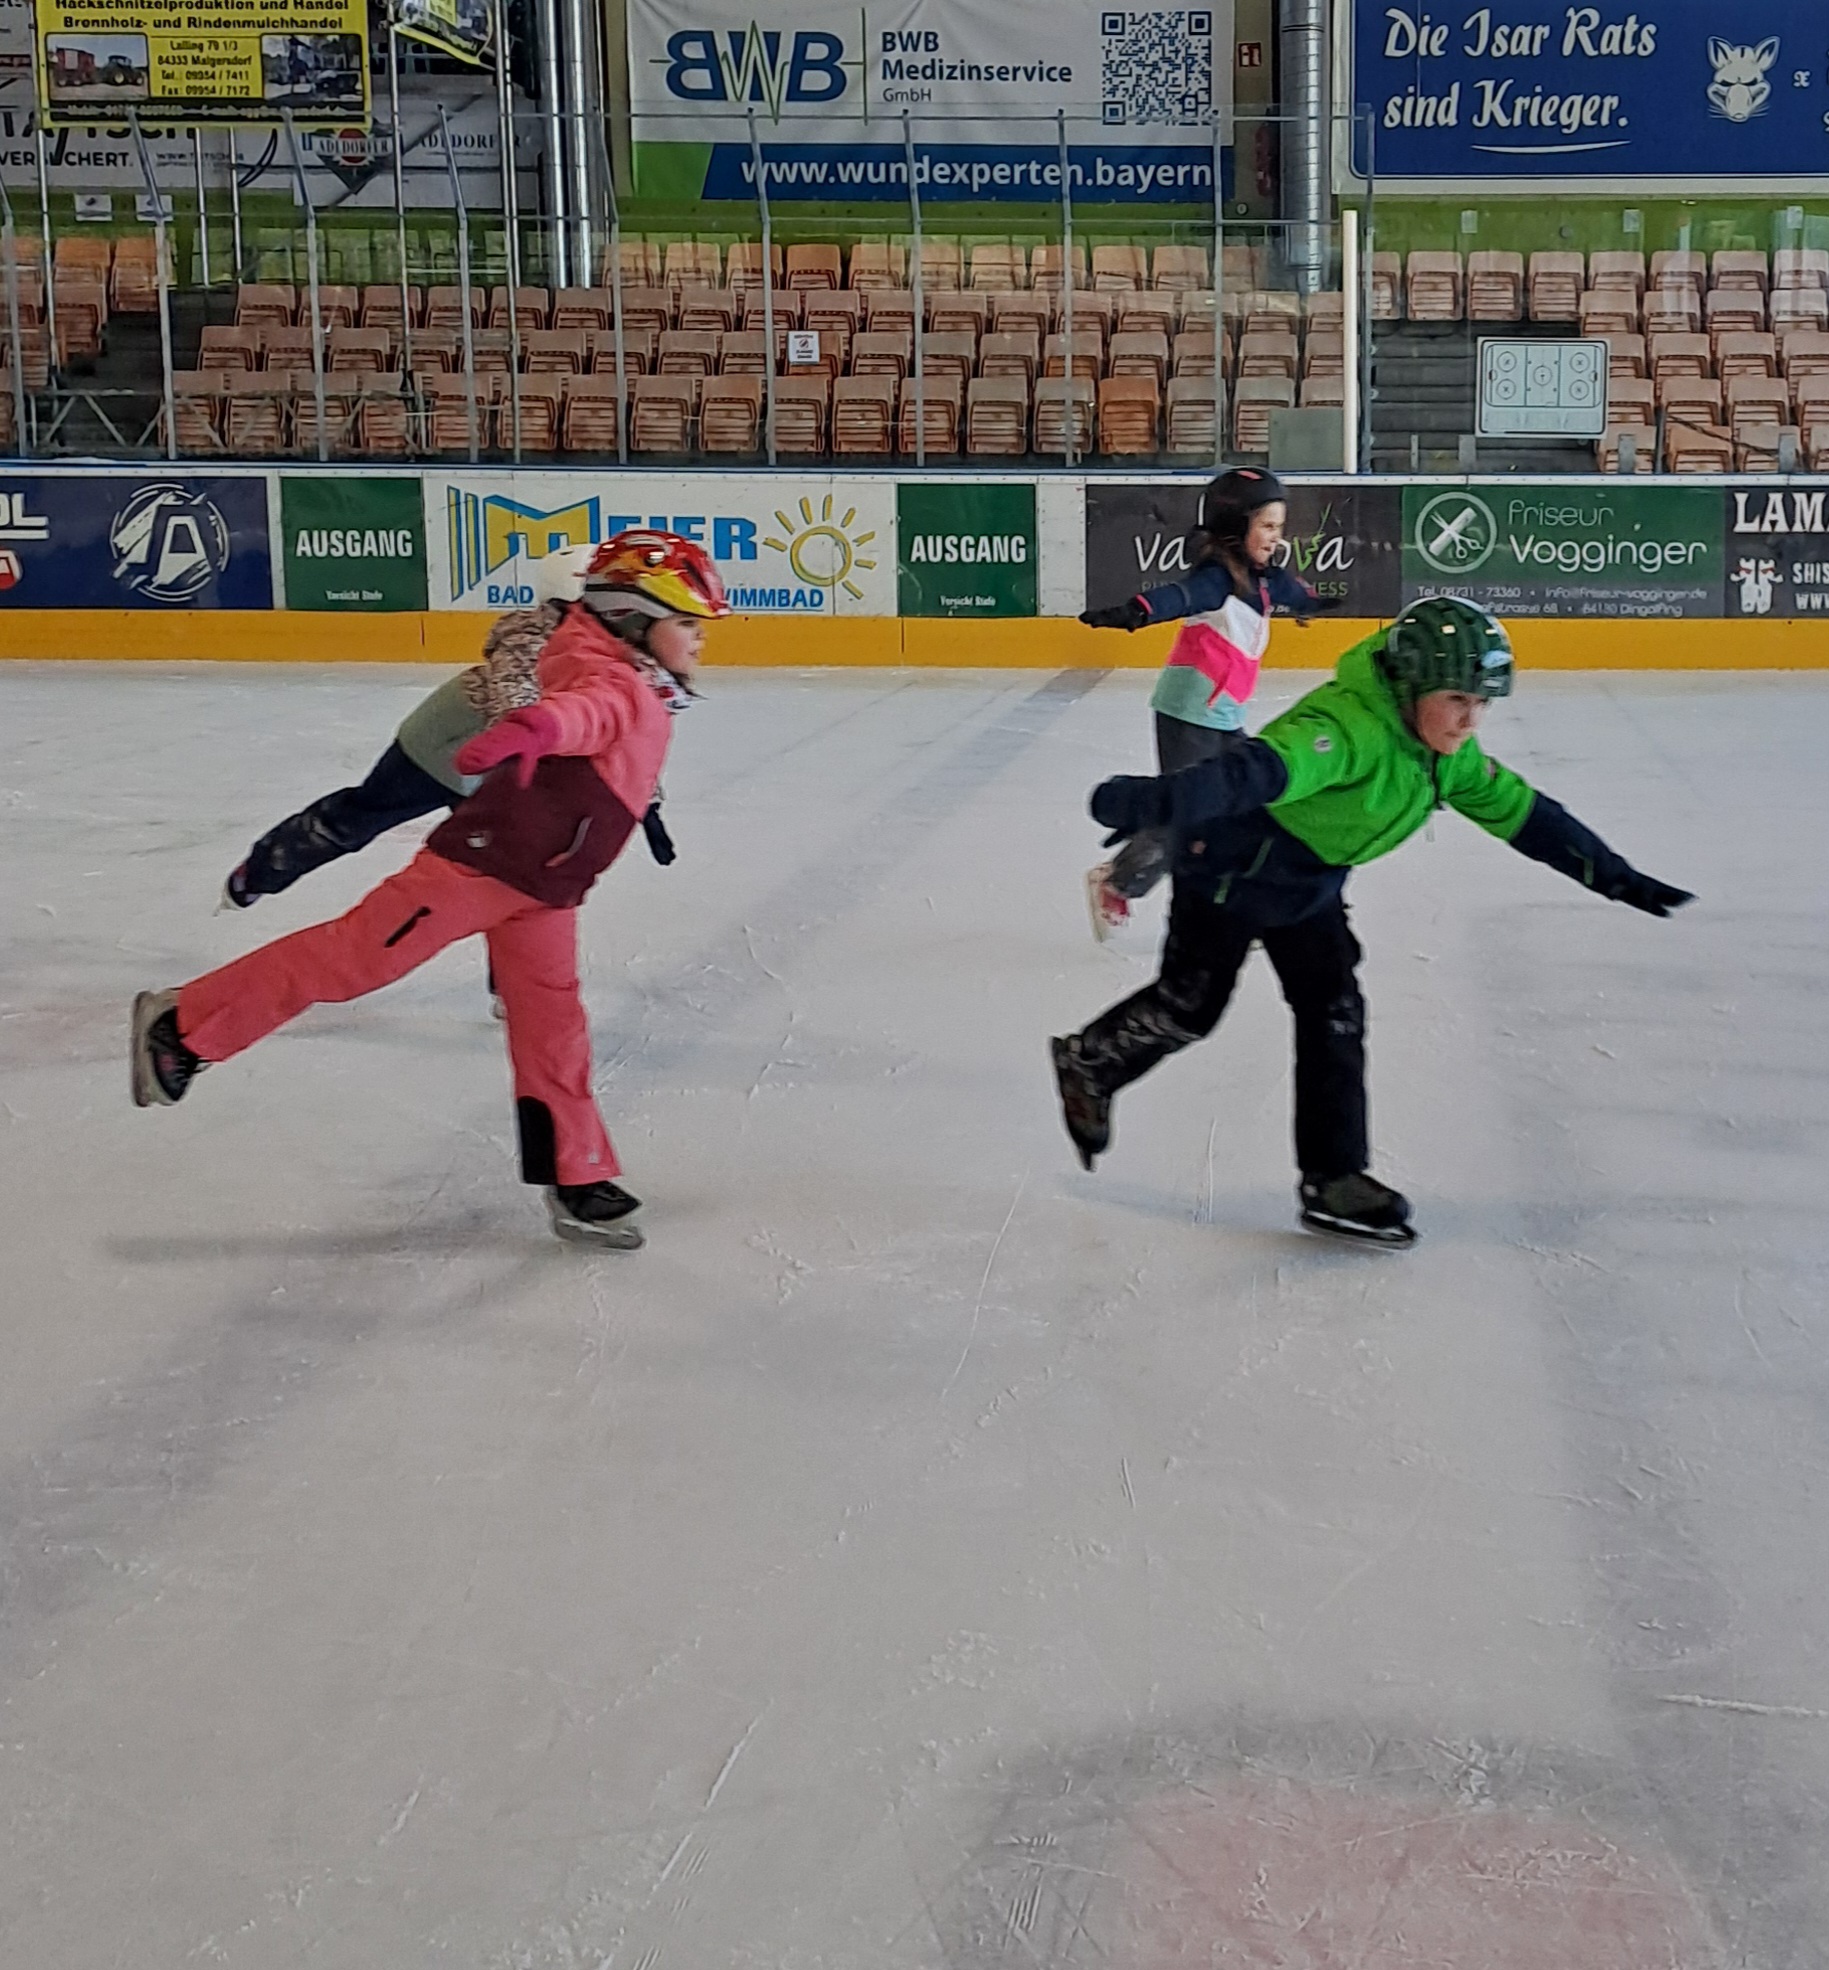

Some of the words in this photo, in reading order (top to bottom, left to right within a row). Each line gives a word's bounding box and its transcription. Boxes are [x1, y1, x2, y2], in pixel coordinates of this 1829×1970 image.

[260, 0, 288, 10] und
[294, 0, 349, 10] Handel
[153, 17, 182, 28] und
[1384, 8, 1449, 58] Die
[1462, 8, 1550, 58] Isar
[1562, 7, 1658, 57] Rats
[881, 31, 940, 53] BWB
[881, 58, 1073, 83] Medizinservice
[882, 88, 932, 102] GmbH
[1383, 82, 1462, 129] sind
[1471, 78, 1630, 135] Krieger.
[741, 154, 1213, 194] www.wundexperten.bayern
[1733, 492, 1829, 533] LAM
[296, 529, 413, 558] AUSGANG
[910, 535, 1026, 563] AUSGANG
[1509, 533, 1707, 574] Vogginger
[487, 585, 535, 605] BAD
